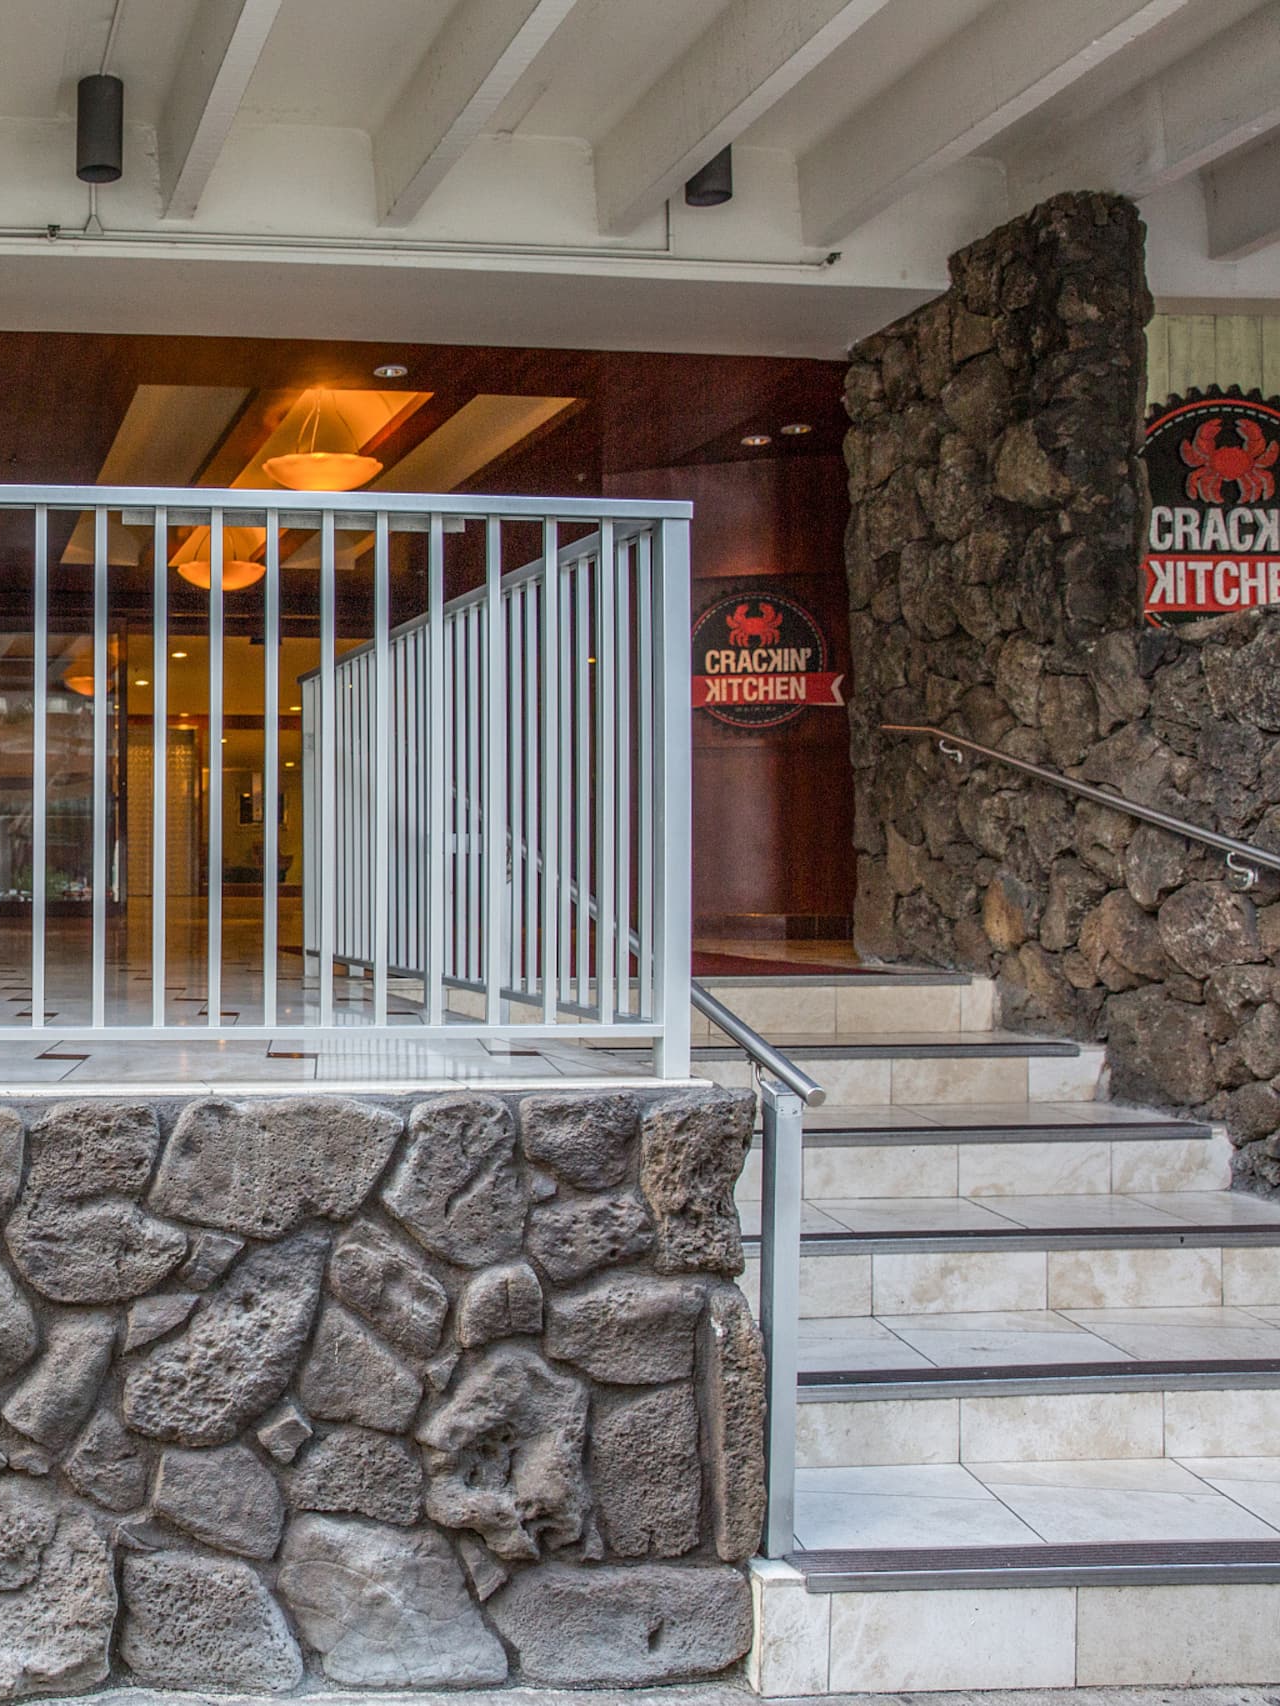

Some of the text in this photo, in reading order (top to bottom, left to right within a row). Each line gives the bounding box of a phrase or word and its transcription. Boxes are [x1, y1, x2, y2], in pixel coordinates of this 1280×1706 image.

[1150, 506, 1280, 551] CRACK
[705, 647, 812, 674] CRACKIN'
[705, 676, 806, 702] KITCHEN
